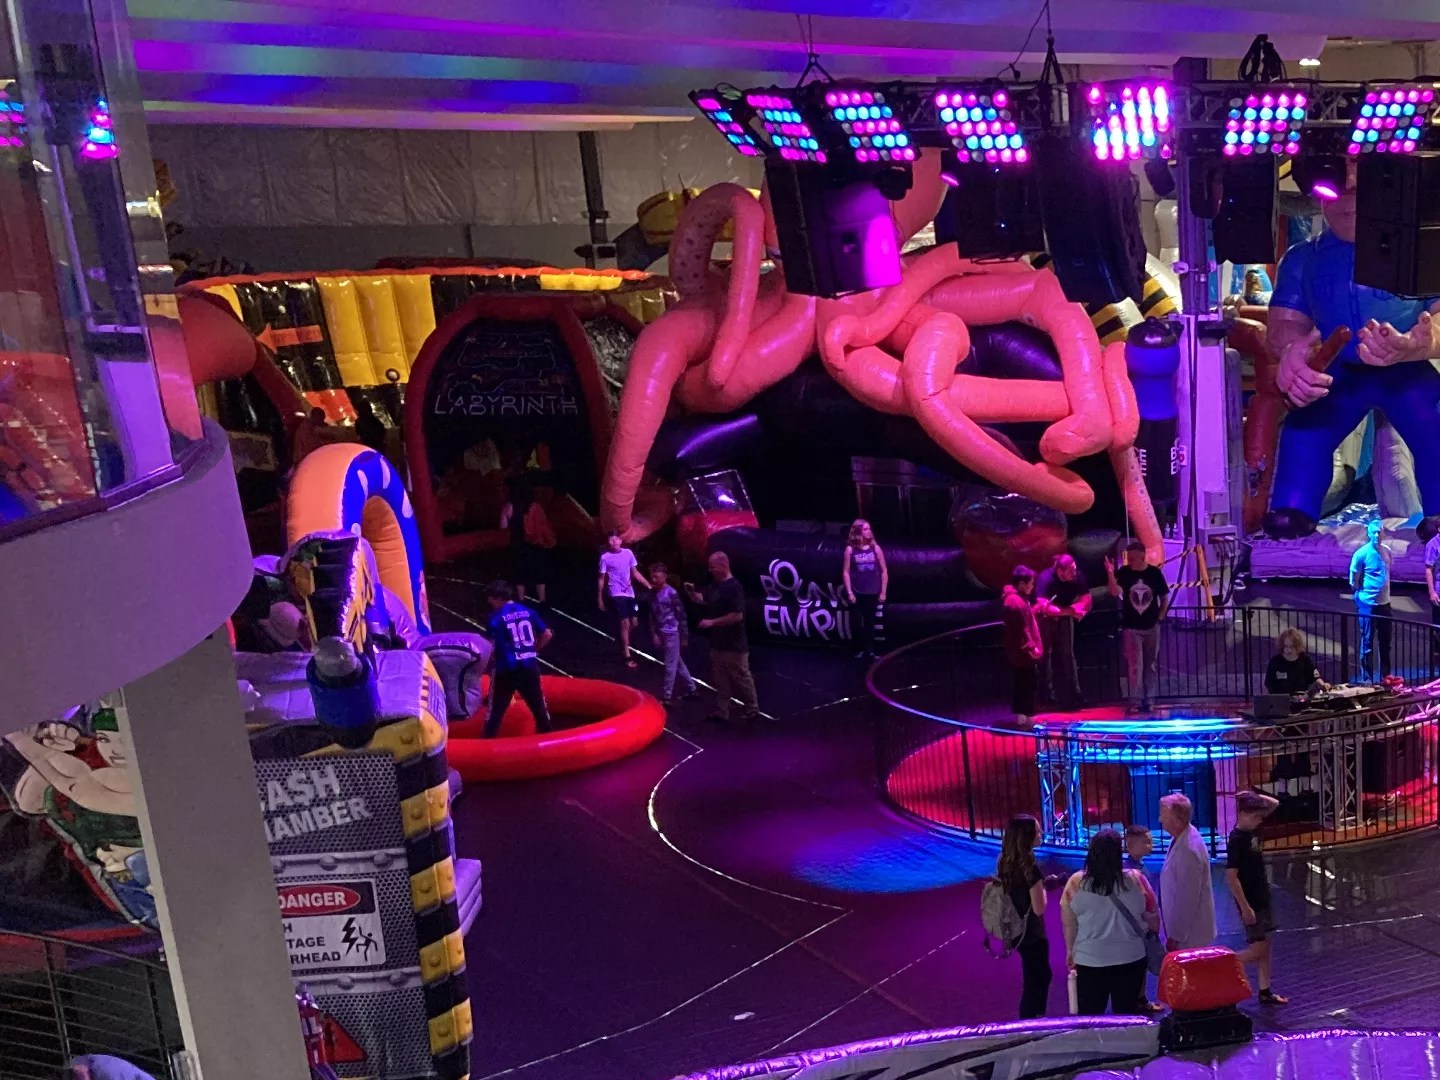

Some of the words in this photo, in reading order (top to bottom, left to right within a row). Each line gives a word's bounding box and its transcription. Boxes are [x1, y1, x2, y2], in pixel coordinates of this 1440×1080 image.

[434, 394, 578, 416] LABYRINTH
[507, 620, 536, 649] 10
[260, 765, 341, 812] ASH
[286, 936, 326, 949] TAGE
[290, 951, 341, 965] RHEAD
